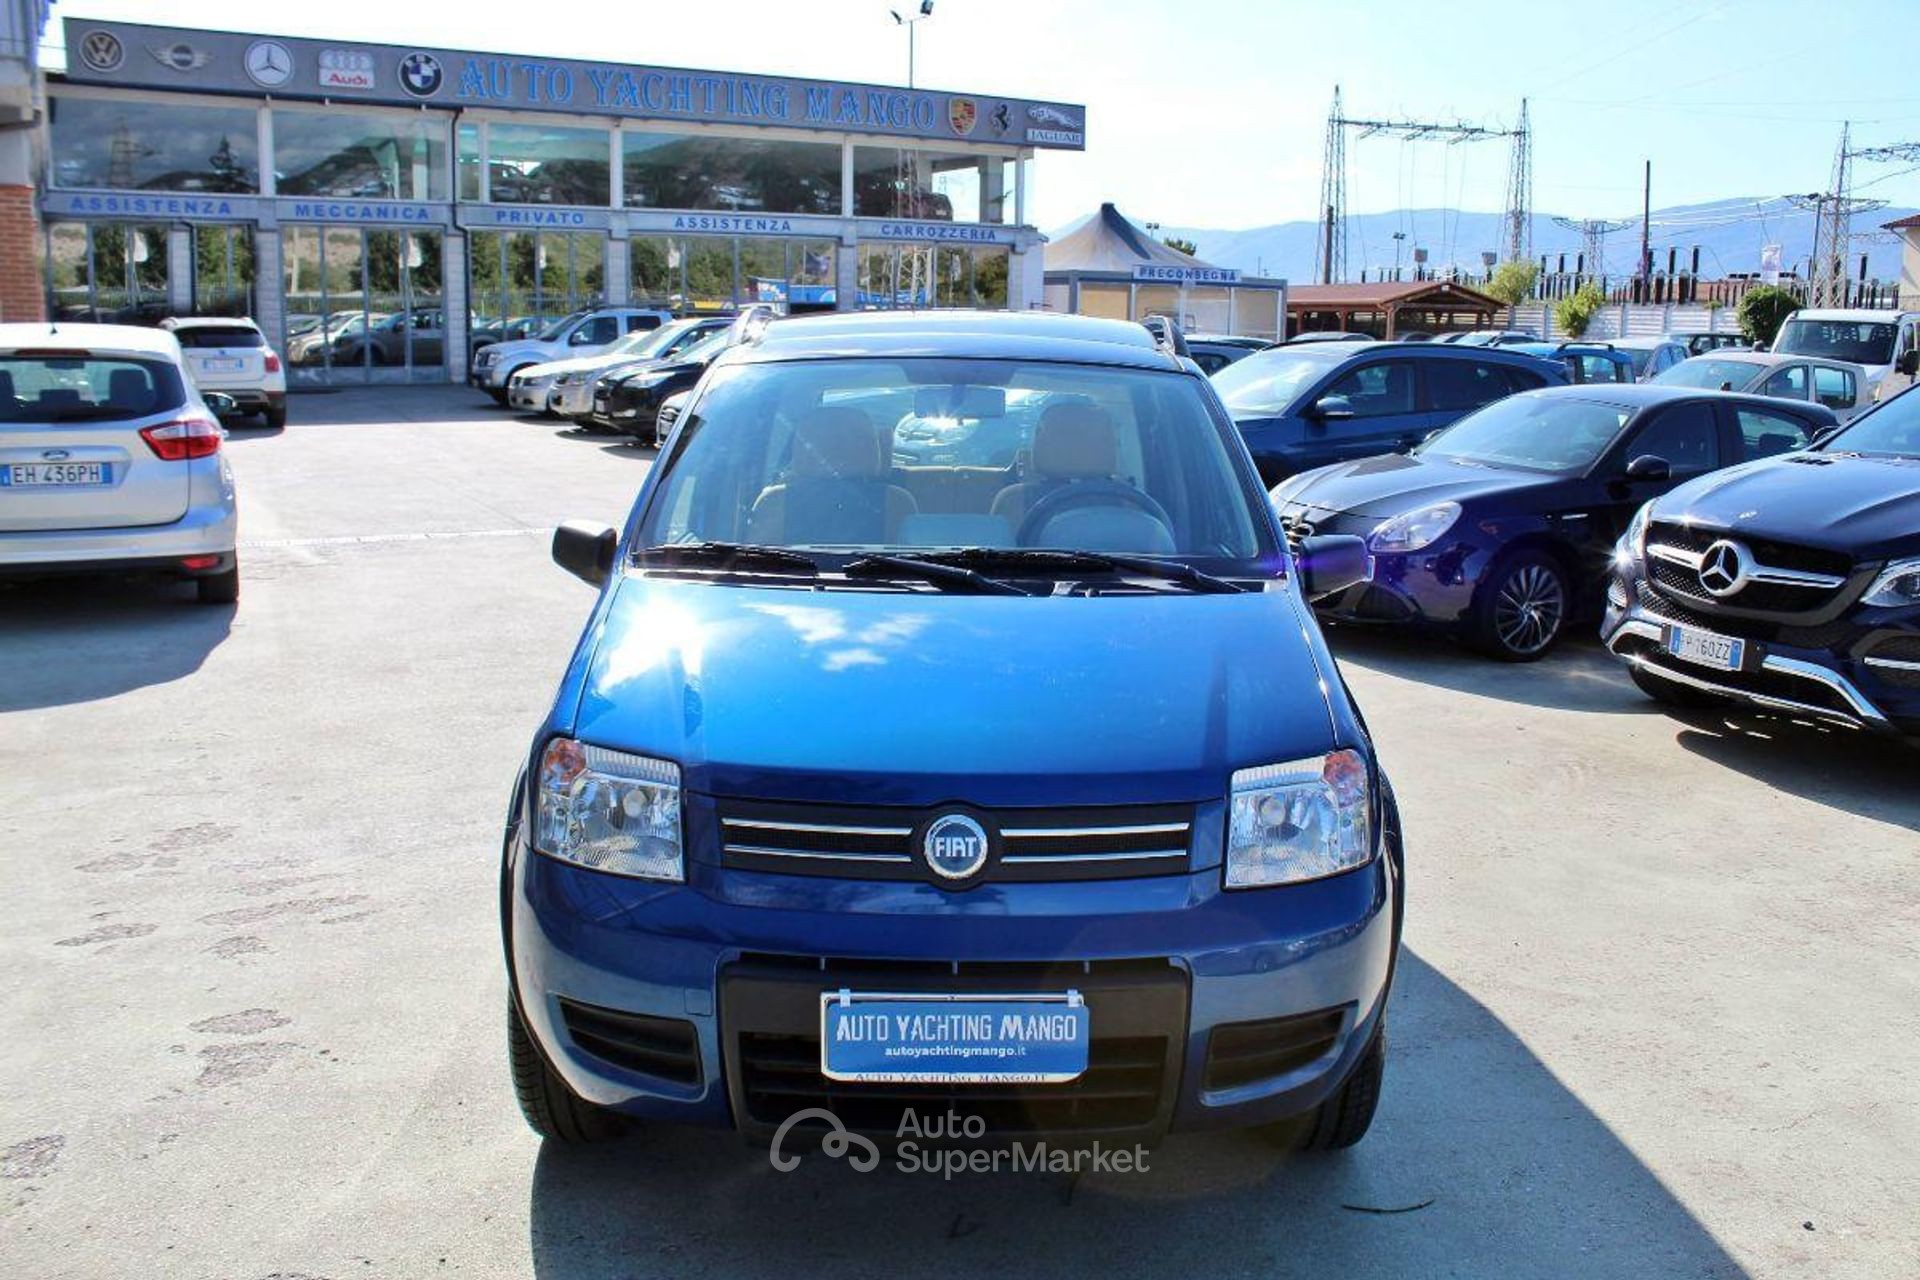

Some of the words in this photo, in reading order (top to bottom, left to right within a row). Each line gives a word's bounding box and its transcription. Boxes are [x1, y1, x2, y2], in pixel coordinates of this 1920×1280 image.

[457, 59, 573, 103] AUTO
[587, 69, 788, 118] YACHTING
[805, 86, 936, 129] MANGO
[70, 196, 232, 216] ASSISTENZA
[295, 203, 430, 219] MECCANICA
[496, 210, 584, 225] PRIVATO
[674, 216, 792, 234] ASSISTENZA
[881, 224, 997, 242] CARROZZERIA
[1139, 267, 1237, 281] PRECONSEGNA
[14, 466, 36, 483] EH
[43, 465, 100, 482] 436PH
[935, 836, 977, 858] FIAT
[836, 1014, 889, 1042] AUTO
[896, 1014, 993, 1042] YACHTING
[999, 1014, 1077, 1042] MANGO
[884, 1045, 1027, 1058] autoyachtingmango.it
